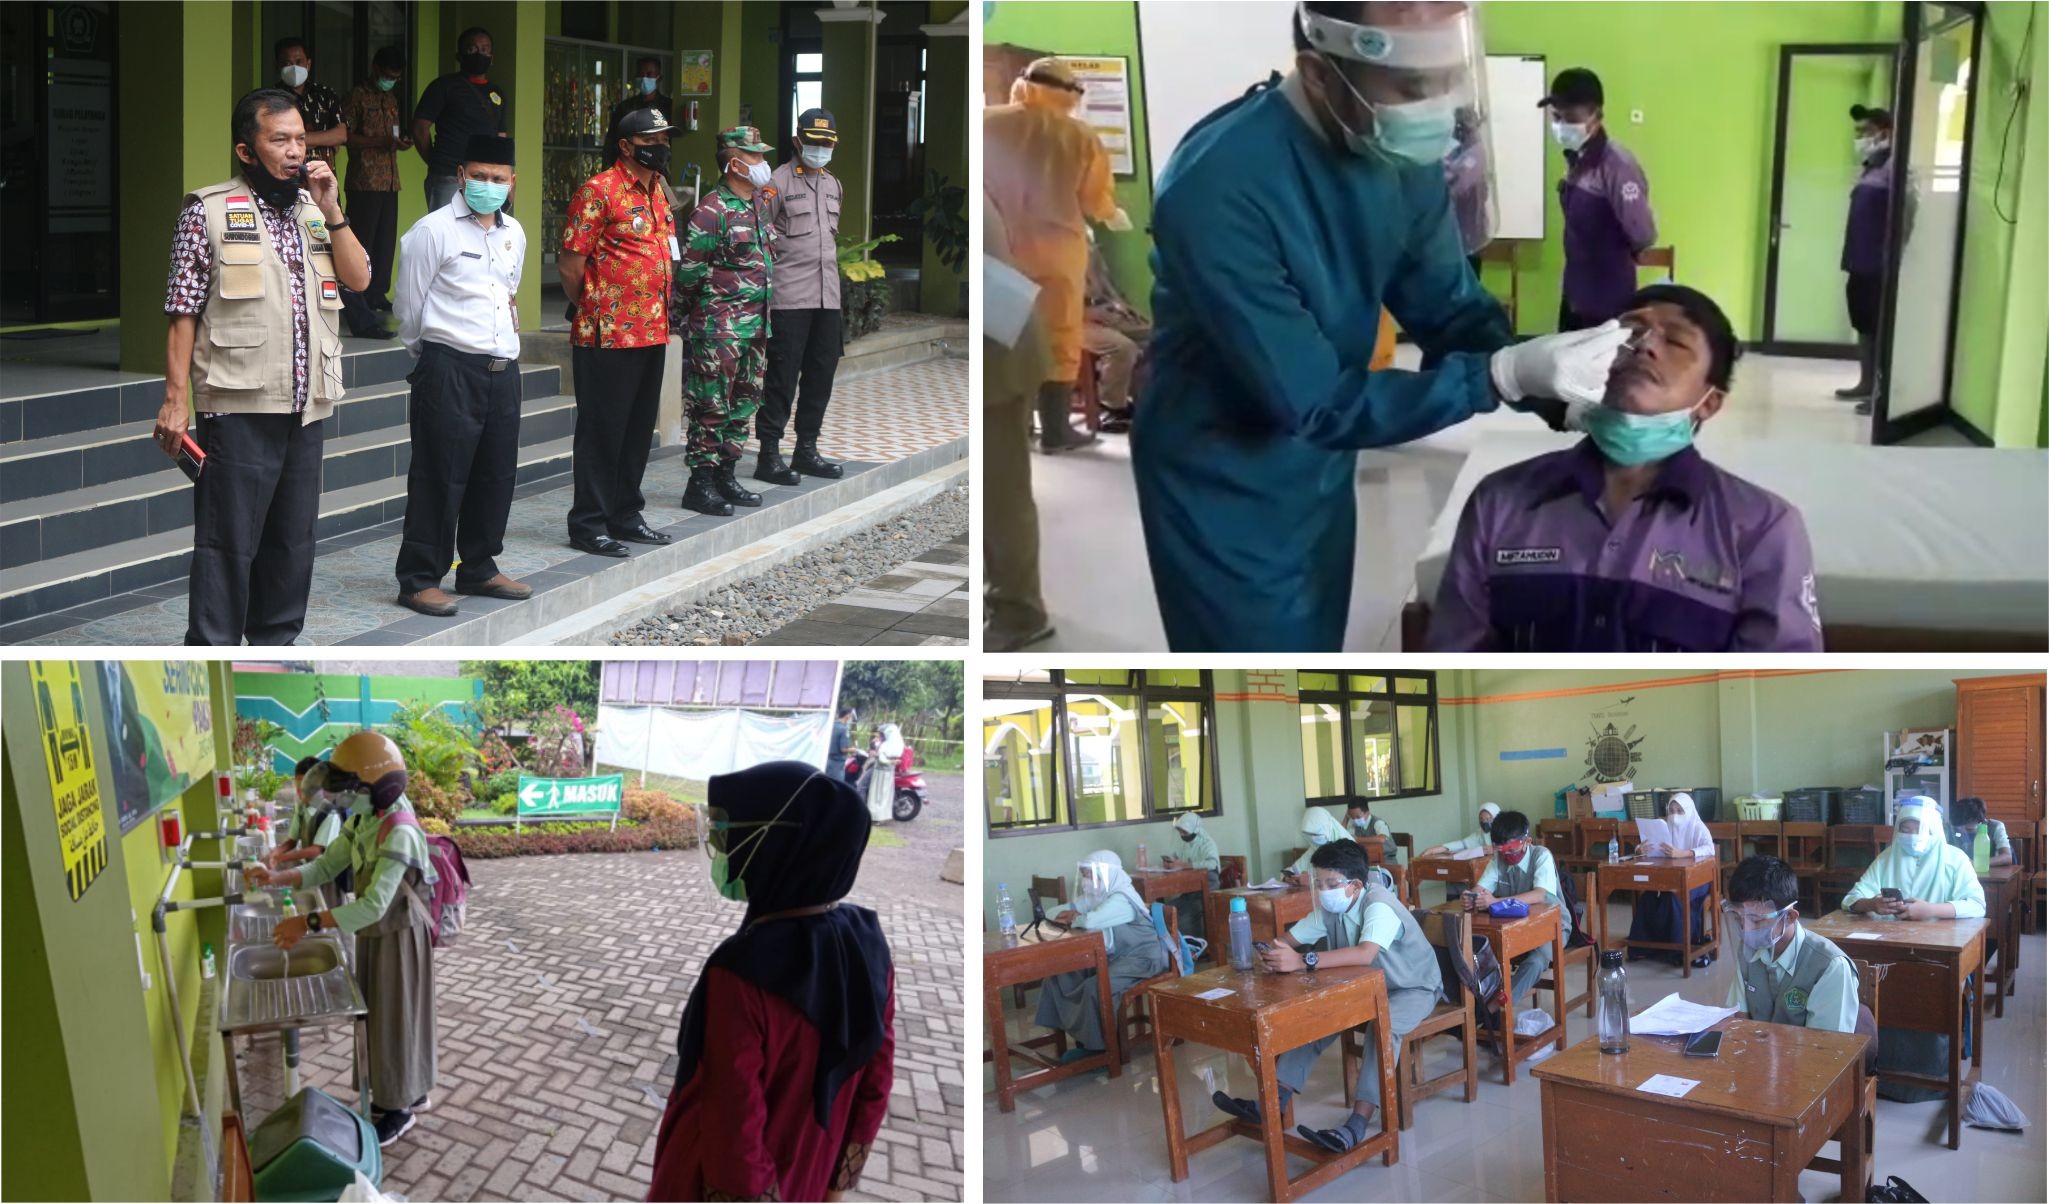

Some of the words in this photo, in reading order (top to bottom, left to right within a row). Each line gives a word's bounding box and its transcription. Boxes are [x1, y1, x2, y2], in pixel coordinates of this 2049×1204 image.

[58, 790, 78, 819] JAGA
[77, 779, 97, 806] JARAK
[565, 784, 617, 802] MASUK
[60, 816, 77, 839] SOCIAL
[76, 798, 100, 825] DISTANCING
